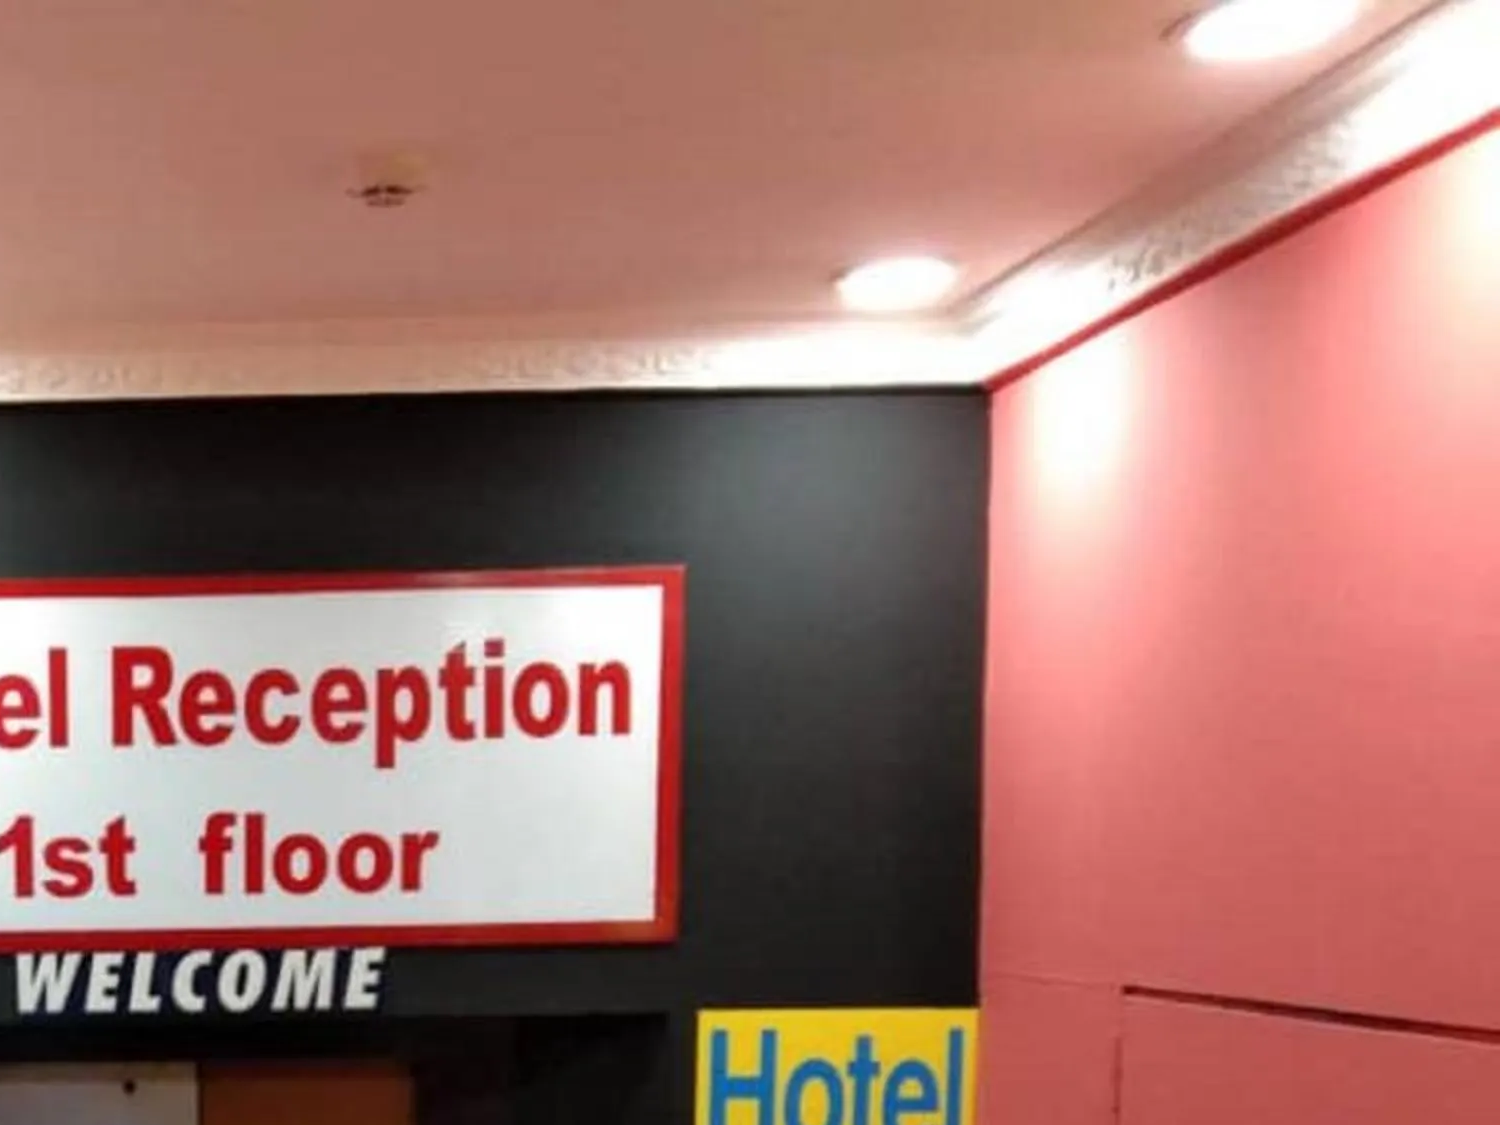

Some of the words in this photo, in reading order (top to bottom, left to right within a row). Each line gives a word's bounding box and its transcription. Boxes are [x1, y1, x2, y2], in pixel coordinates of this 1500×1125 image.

[111, 638, 632, 770] Reception
[197, 812, 440, 896] floor
[15, 946, 387, 1014] WELCOME
